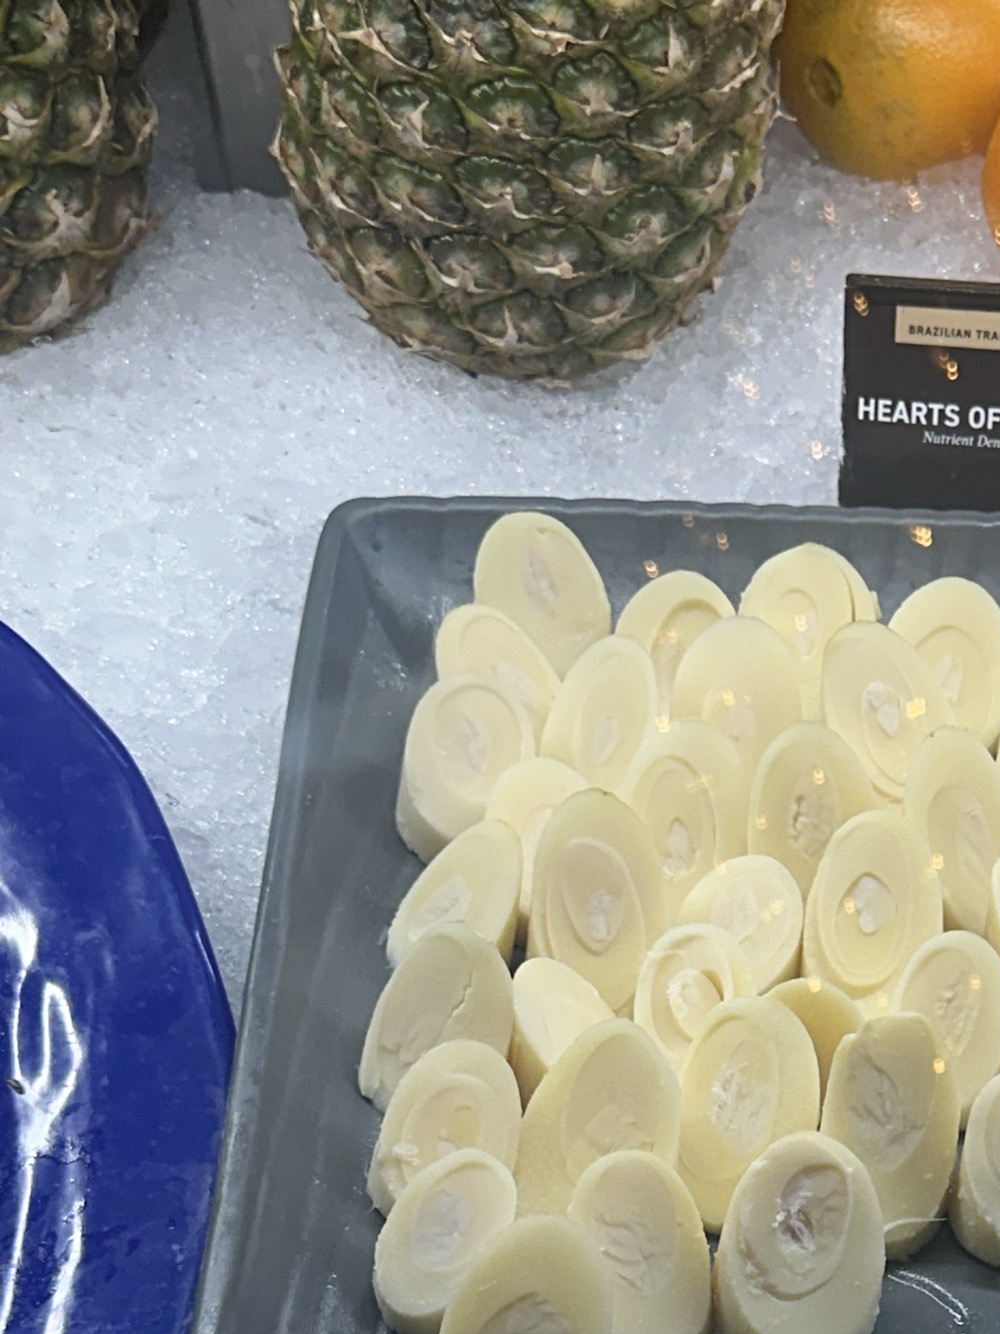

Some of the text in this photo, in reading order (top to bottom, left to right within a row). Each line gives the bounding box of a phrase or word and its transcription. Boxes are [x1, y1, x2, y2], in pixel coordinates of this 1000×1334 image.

[908, 324, 972, 339] BRAZILIAN
[857, 397, 960, 428] HEARTS
[922, 430, 974, 448] Nutrient
